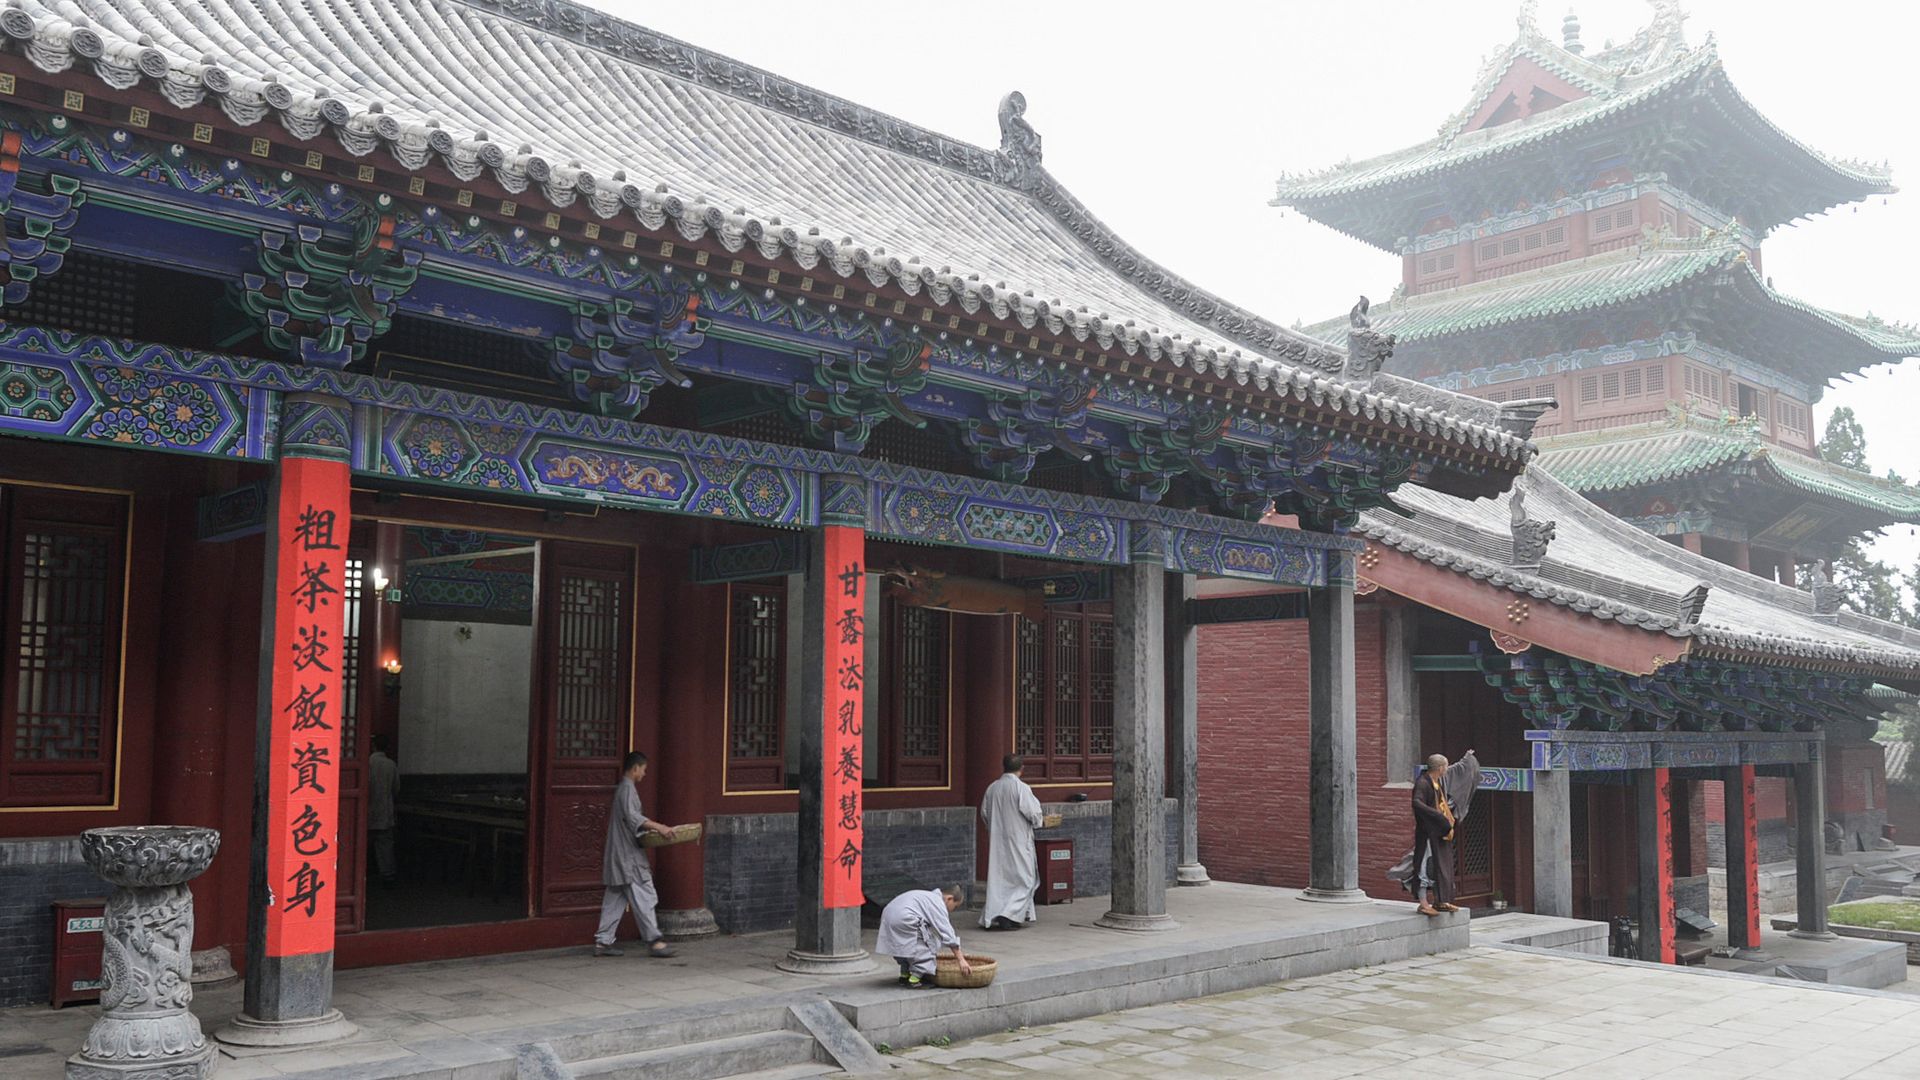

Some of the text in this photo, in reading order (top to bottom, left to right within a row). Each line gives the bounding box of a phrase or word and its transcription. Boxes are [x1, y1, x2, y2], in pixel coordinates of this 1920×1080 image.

[285, 504, 341, 918] 粗茶淡飯資色身
[834, 562, 862, 880] 甘露法乳養慧命
